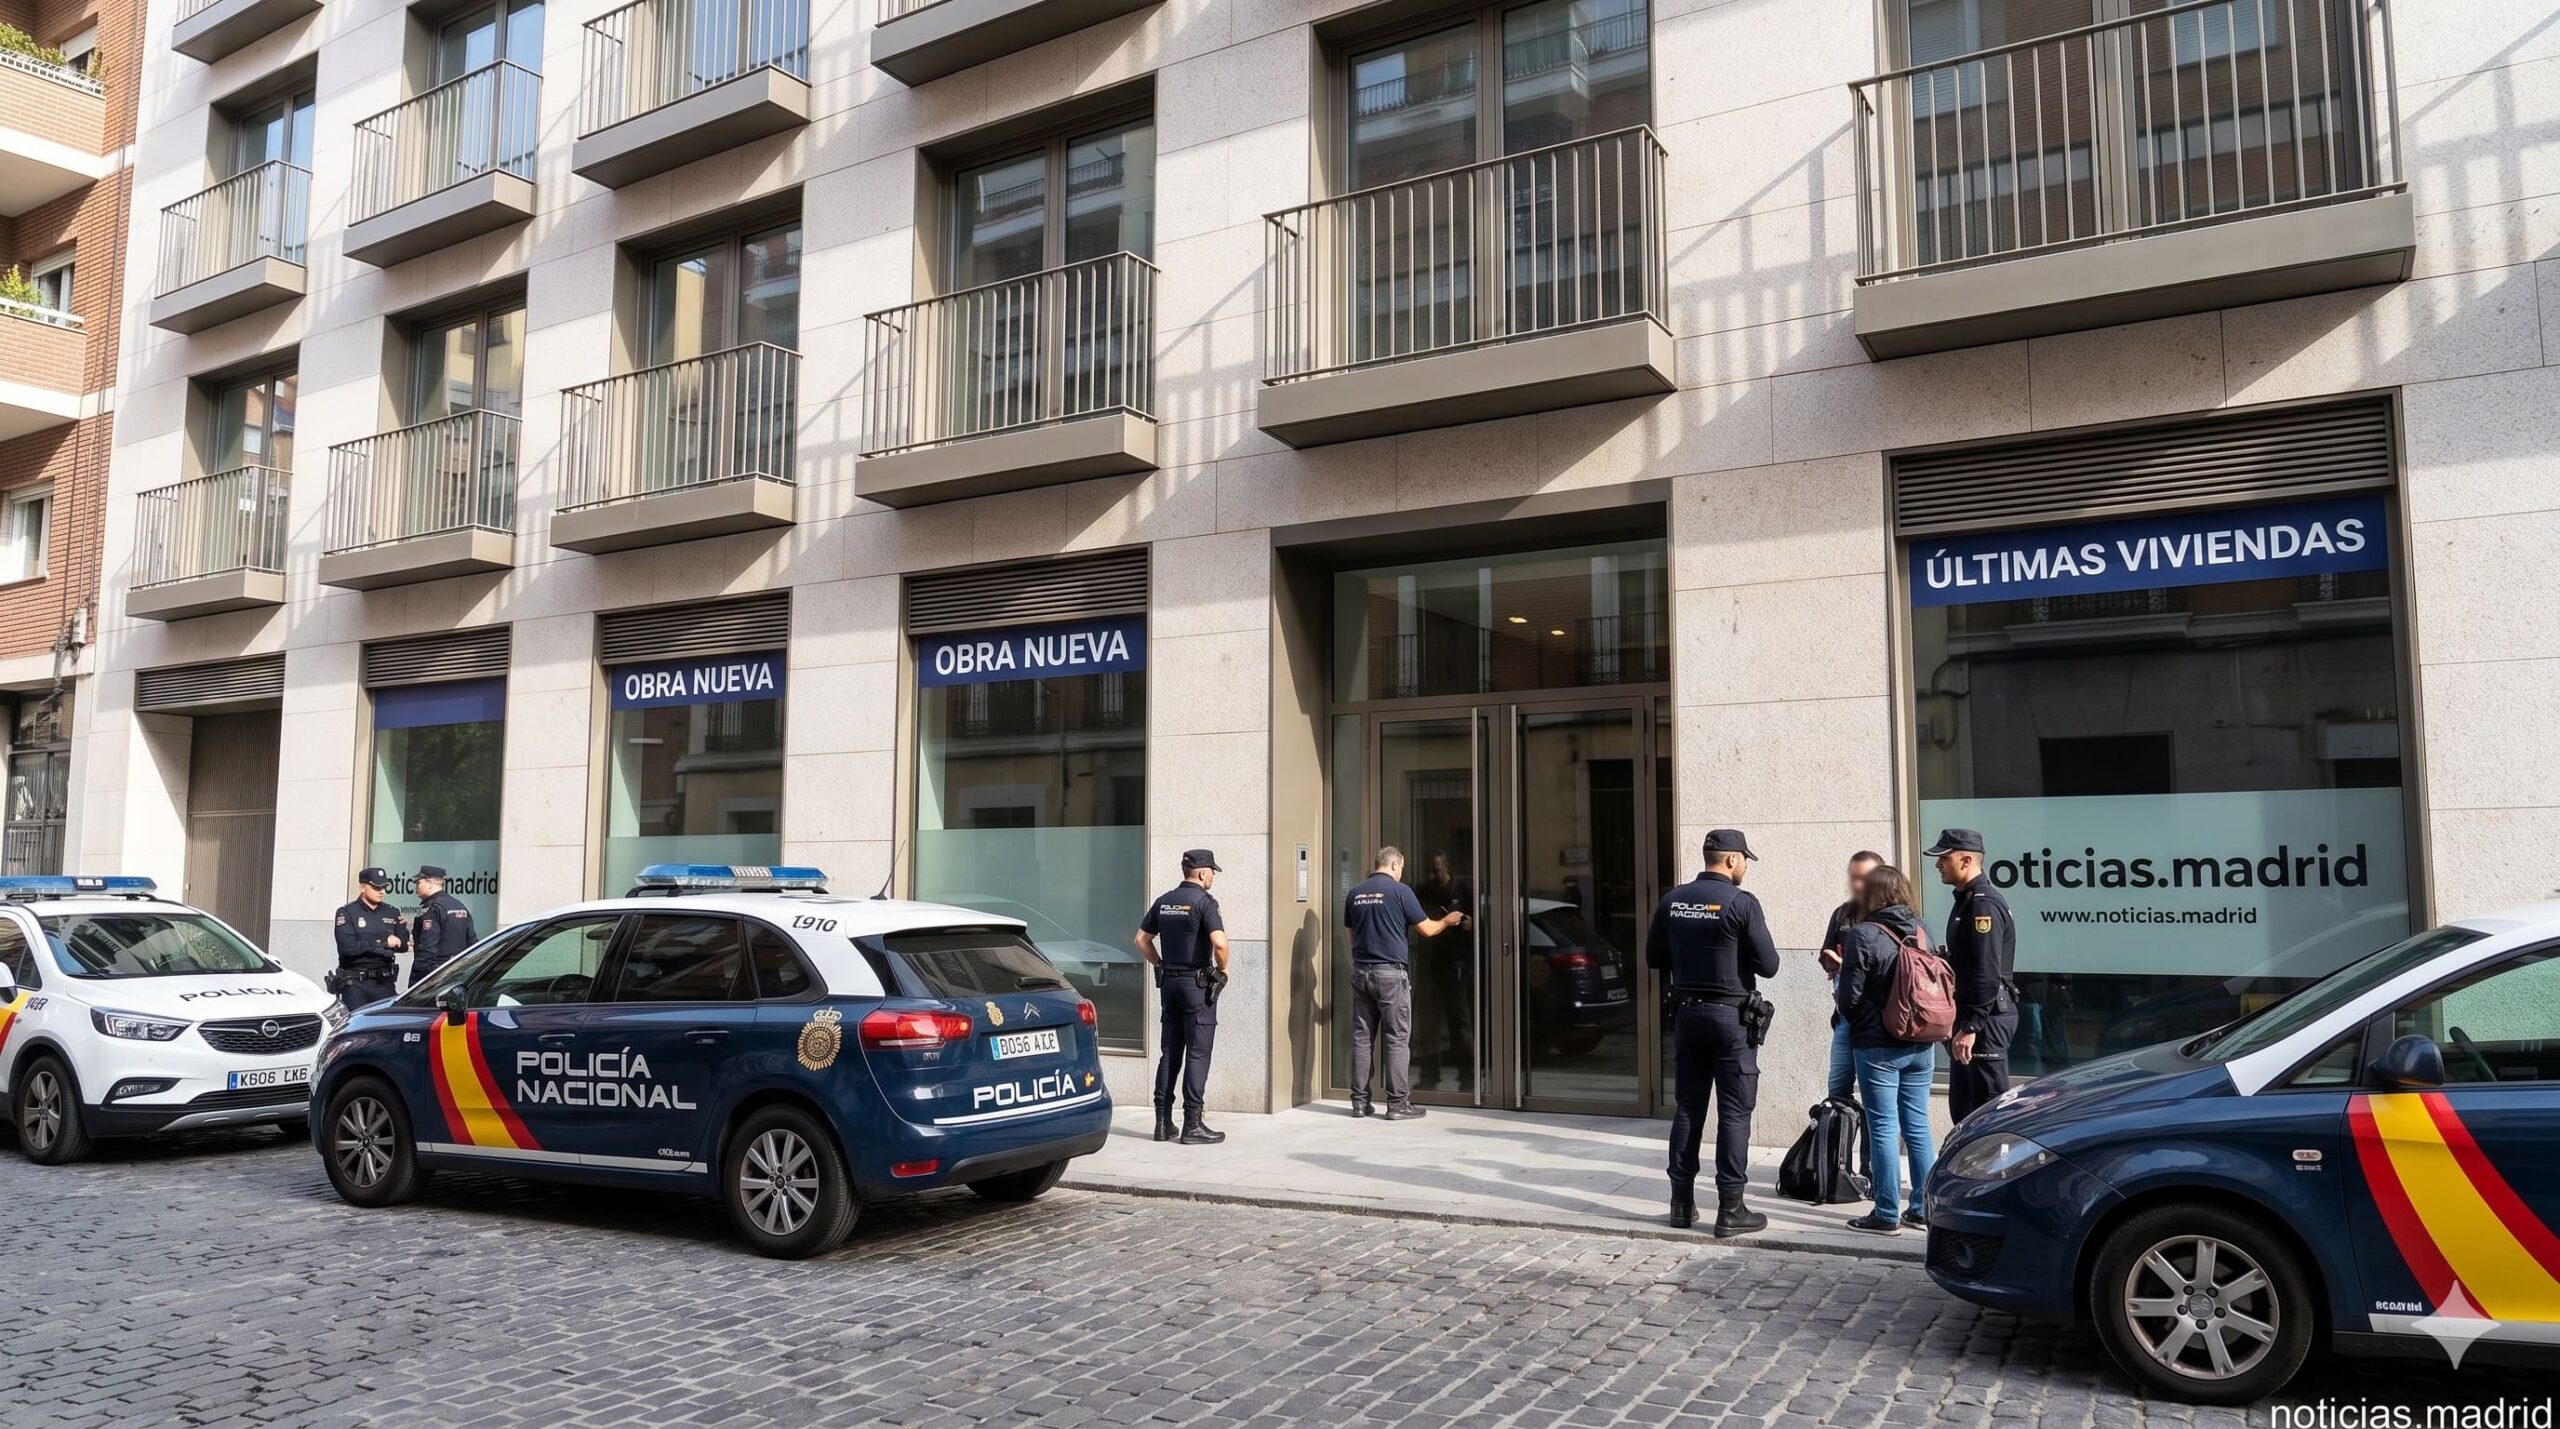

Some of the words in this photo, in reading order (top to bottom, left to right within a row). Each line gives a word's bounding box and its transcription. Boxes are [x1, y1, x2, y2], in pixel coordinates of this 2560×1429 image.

[1926, 543, 2106, 588] ÚLTIMAS
[2117, 518, 2366, 572] VIVIENDAS
[935, 640, 1016, 676] OBRA
[1024, 629, 1130, 668] NUEVA
[625, 671, 687, 700] OBRA
[693, 662, 774, 694] NUEVA
[1988, 844, 2369, 888] oticias.madrid
[2040, 907, 2257, 924] www.noticias.madrid
[517, 1046, 652, 1079] POLICÍA
[517, 1079, 697, 1110] NACIONAL
[973, 1069, 1077, 1109] POLICÍA
